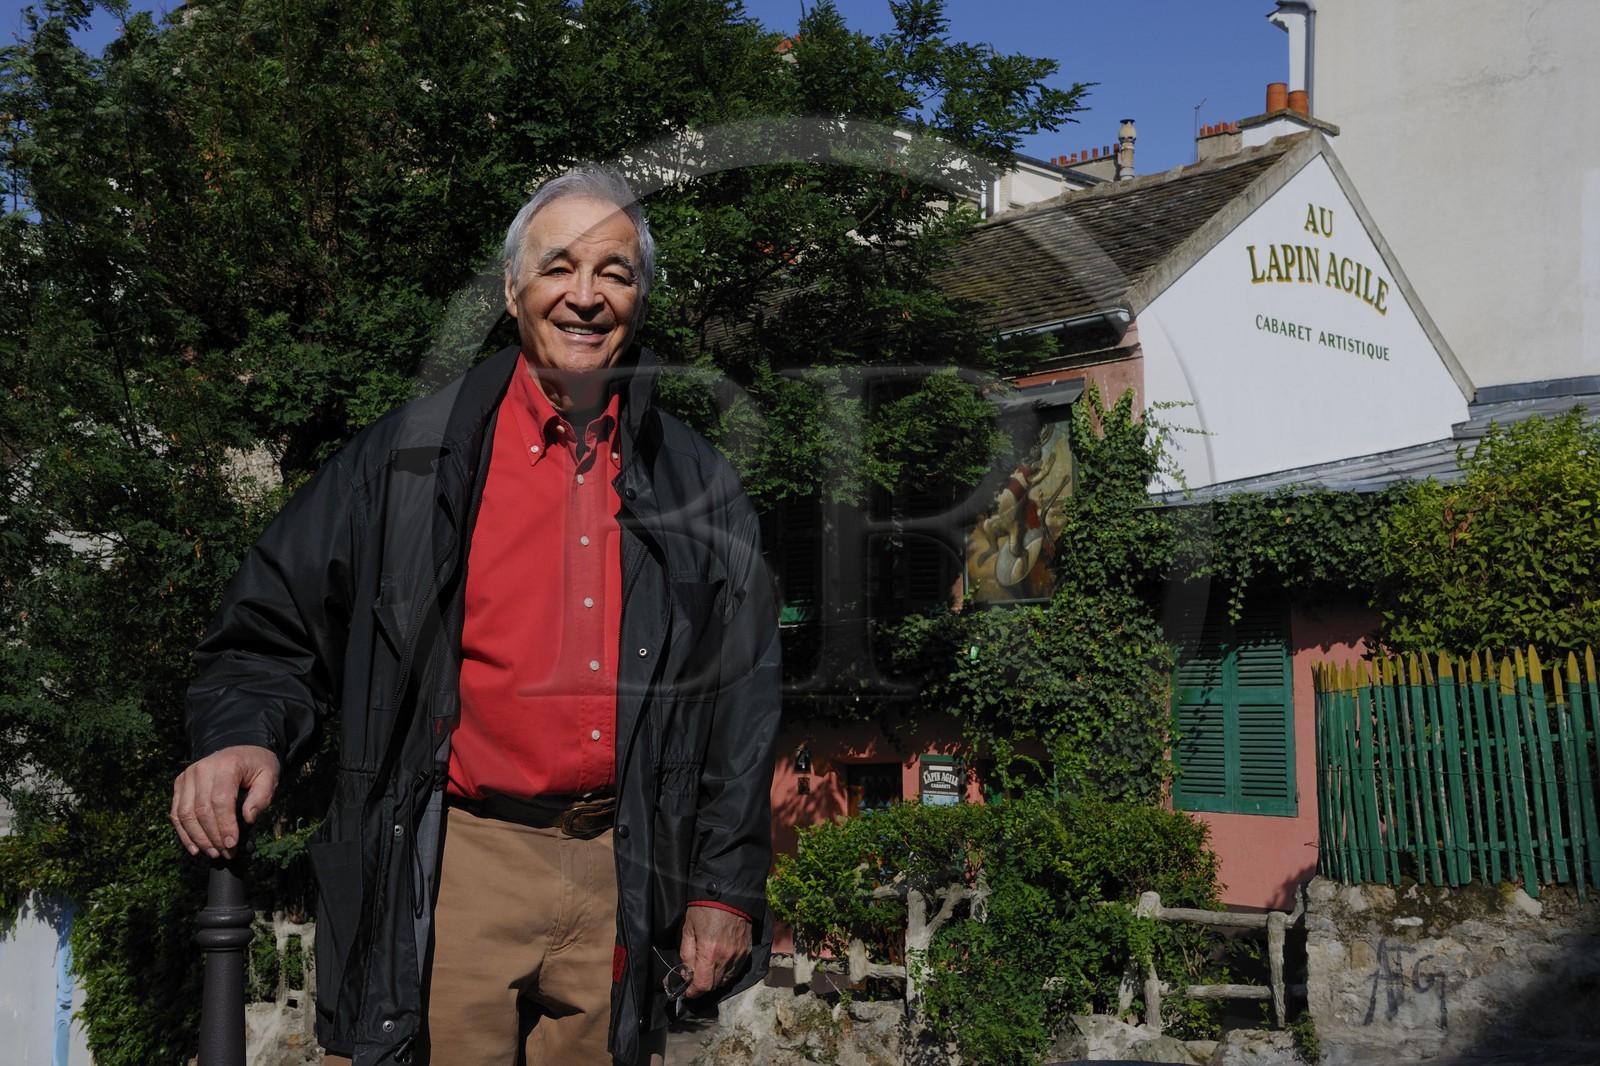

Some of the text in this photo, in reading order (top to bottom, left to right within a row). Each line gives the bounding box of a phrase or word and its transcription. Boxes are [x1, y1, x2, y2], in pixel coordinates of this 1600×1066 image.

[1304, 203, 1334, 238] AU
[1246, 244, 1389, 316] LAPIN AGILE
[1255, 314, 1390, 361] CABARET ARTISTIQUE
